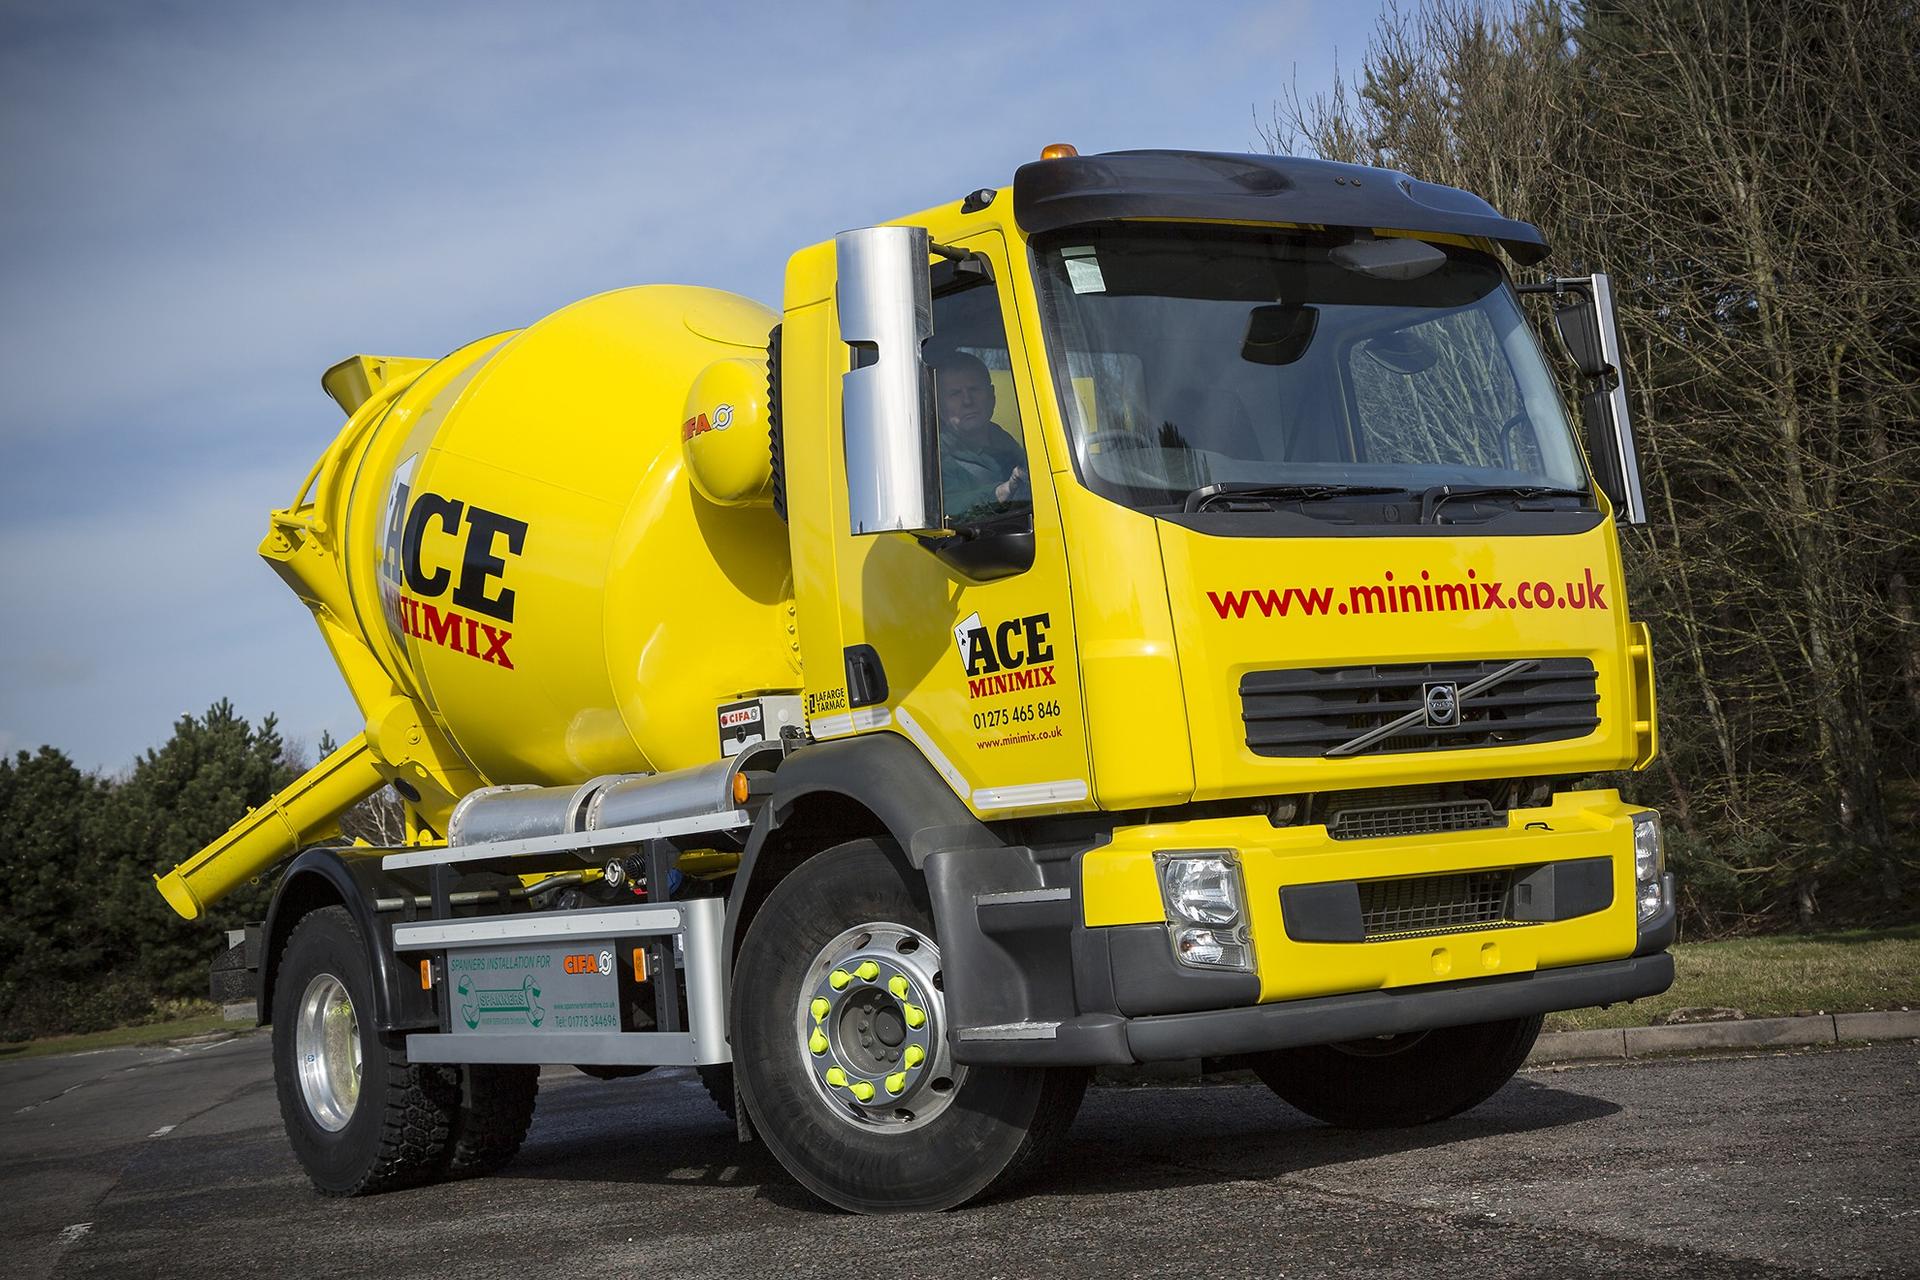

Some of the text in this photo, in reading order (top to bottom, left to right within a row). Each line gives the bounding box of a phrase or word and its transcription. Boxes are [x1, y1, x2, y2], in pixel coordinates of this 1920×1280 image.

[383, 482, 529, 624] ACE
[1206, 568, 1609, 620] www.minimix.co.uk
[967, 612, 1055, 677] ACE
[968, 665, 1057, 699] MINIMIX
[815, 687, 845, 703] LAFARGE
[816, 698, 846, 713] TARMAC
[729, 711, 750, 723] CIFA
[973, 700, 1061, 730] 01275 465 846
[976, 725, 1063, 750] www.minimix.co.uk
[451, 955, 551, 972] SPANNERS INSTALLATION FOR
[563, 954, 600, 975] CIFA
[480, 991, 525, 1007] SPANNERS
[567, 1015, 589, 1028] 01778
[589, 1014, 617, 1027] 344696
